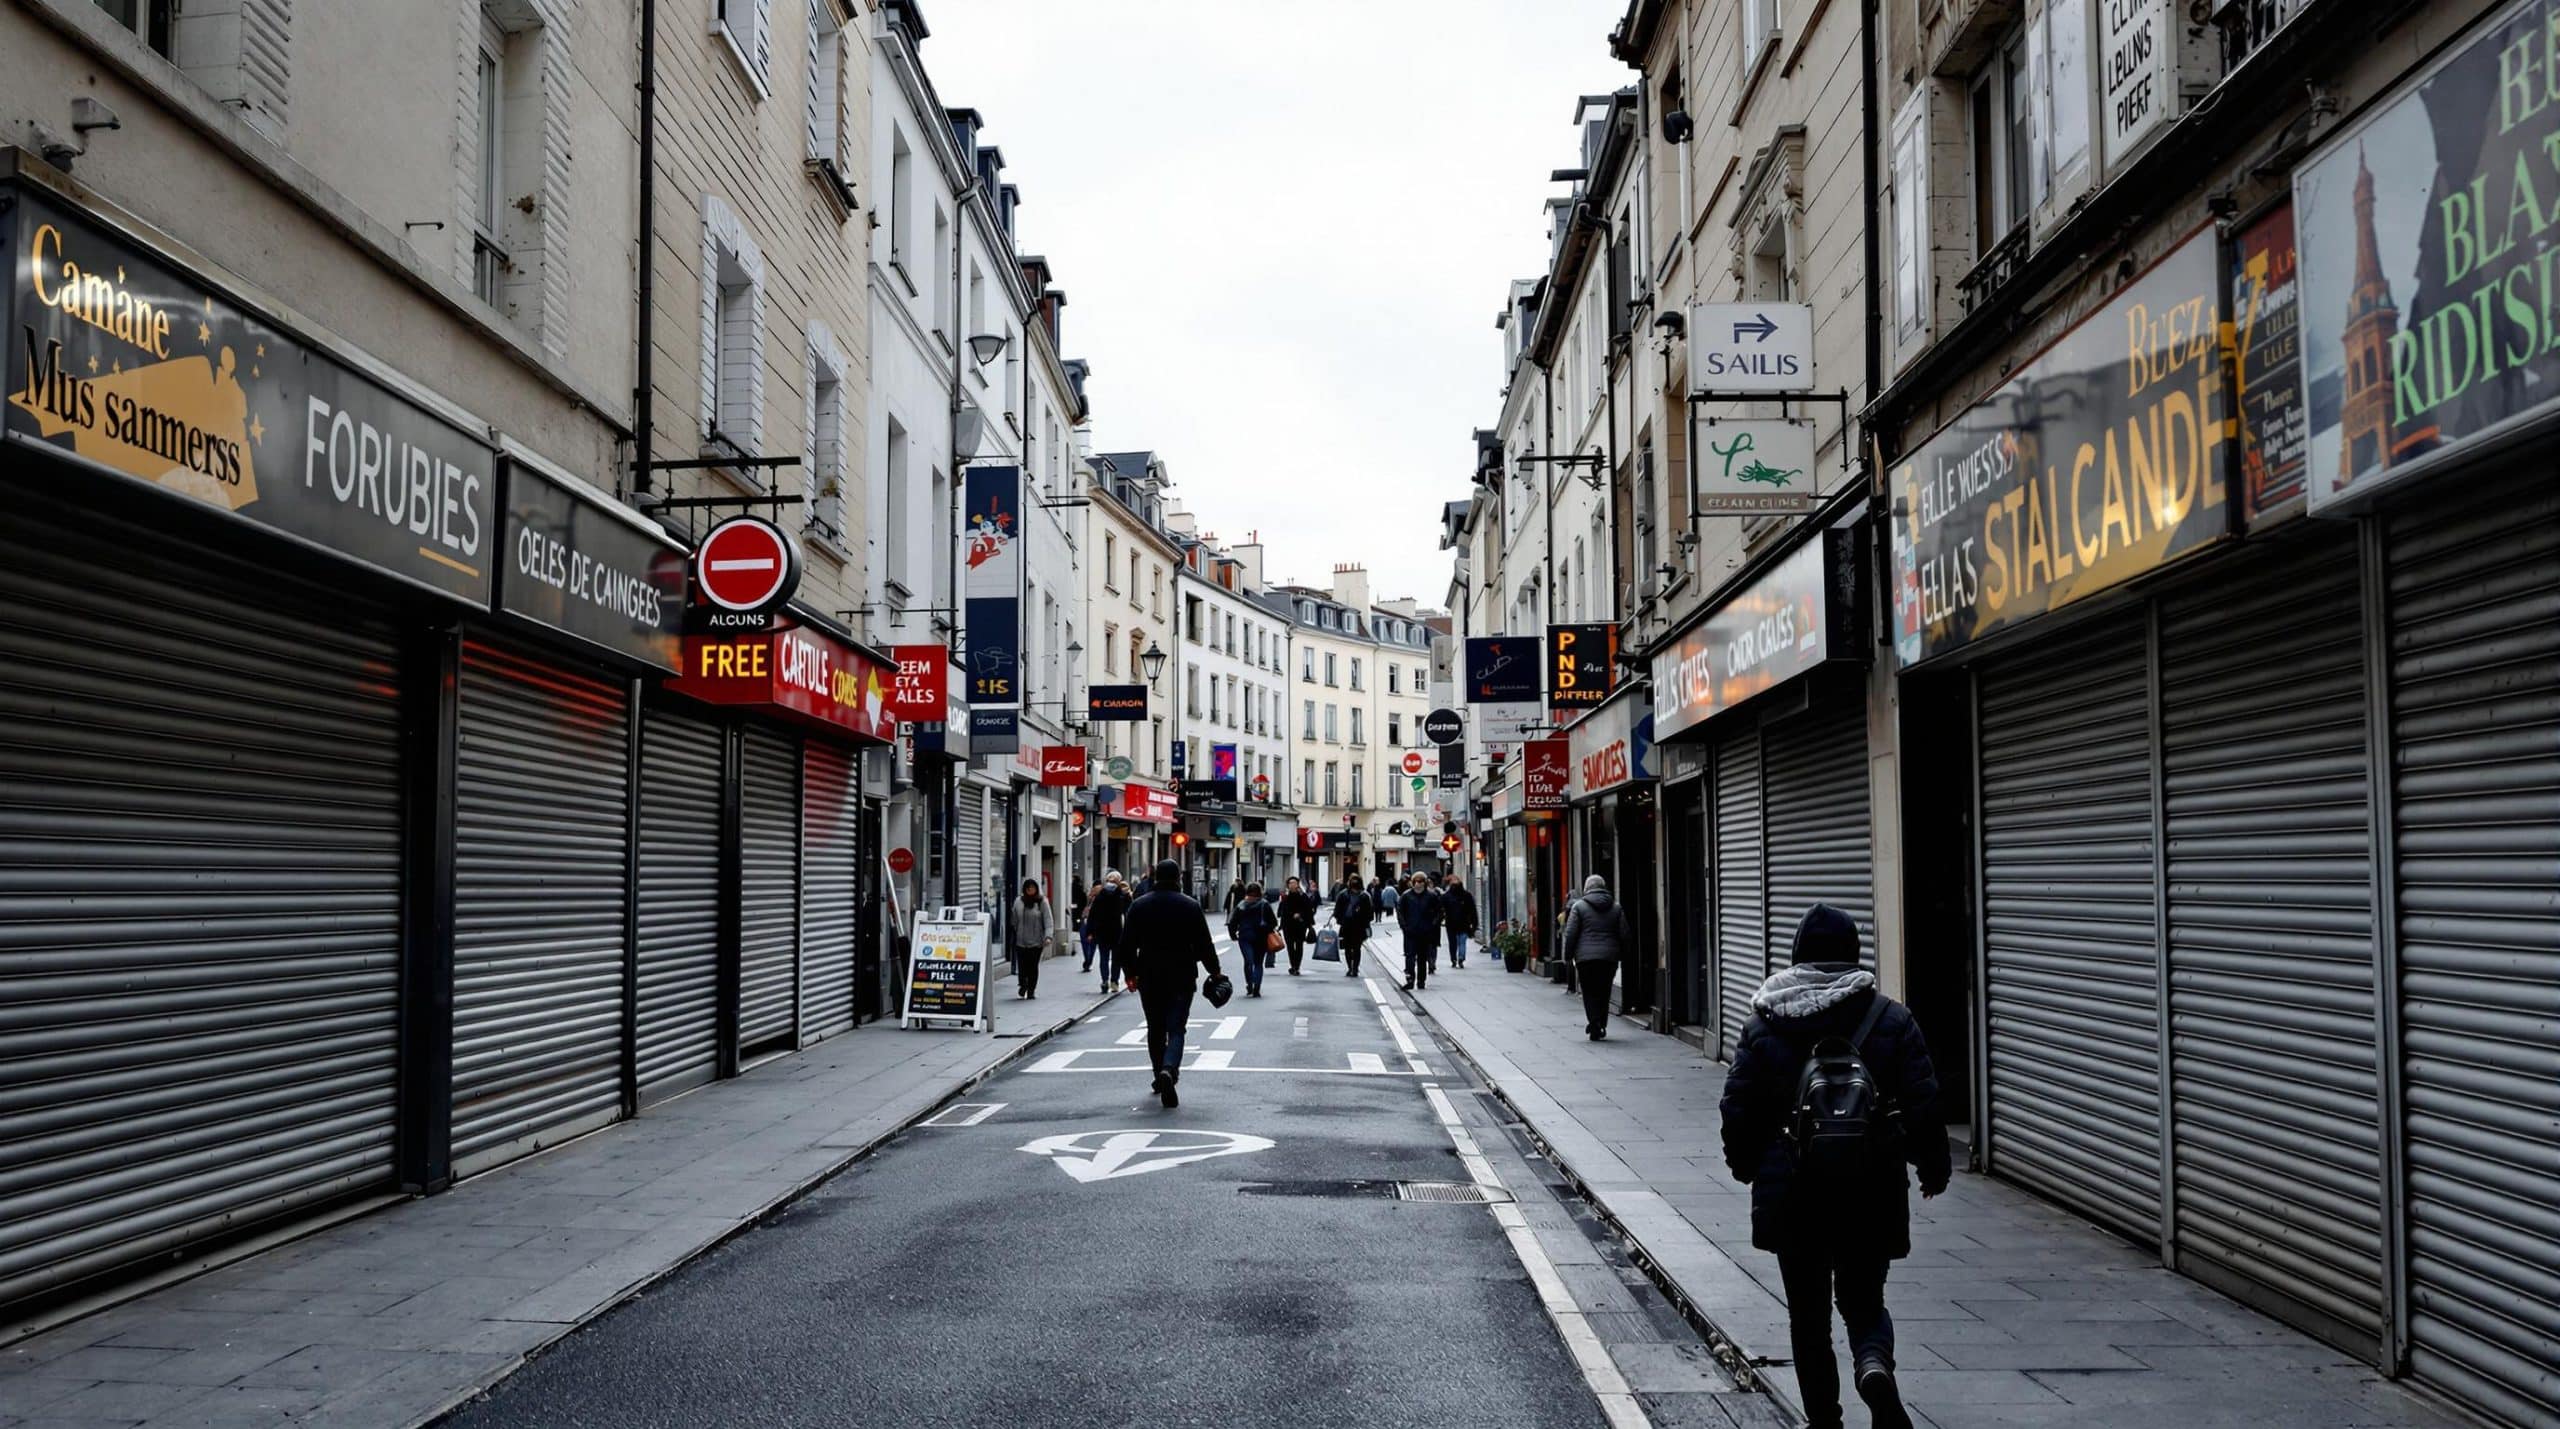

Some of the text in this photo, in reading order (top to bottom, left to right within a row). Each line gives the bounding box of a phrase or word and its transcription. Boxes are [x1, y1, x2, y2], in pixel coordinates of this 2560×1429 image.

[21, 325, 95, 430] Mus
[1707, 352, 1799, 375] SAILIS
[305, 395, 480, 556] FORUBIES
[1984, 371, 2226, 611] STALCANDE
[518, 526, 566, 589] OELES
[570, 550, 591, 600] DE
[701, 644, 767, 678] FREE
[896, 689, 935, 703] ALES
